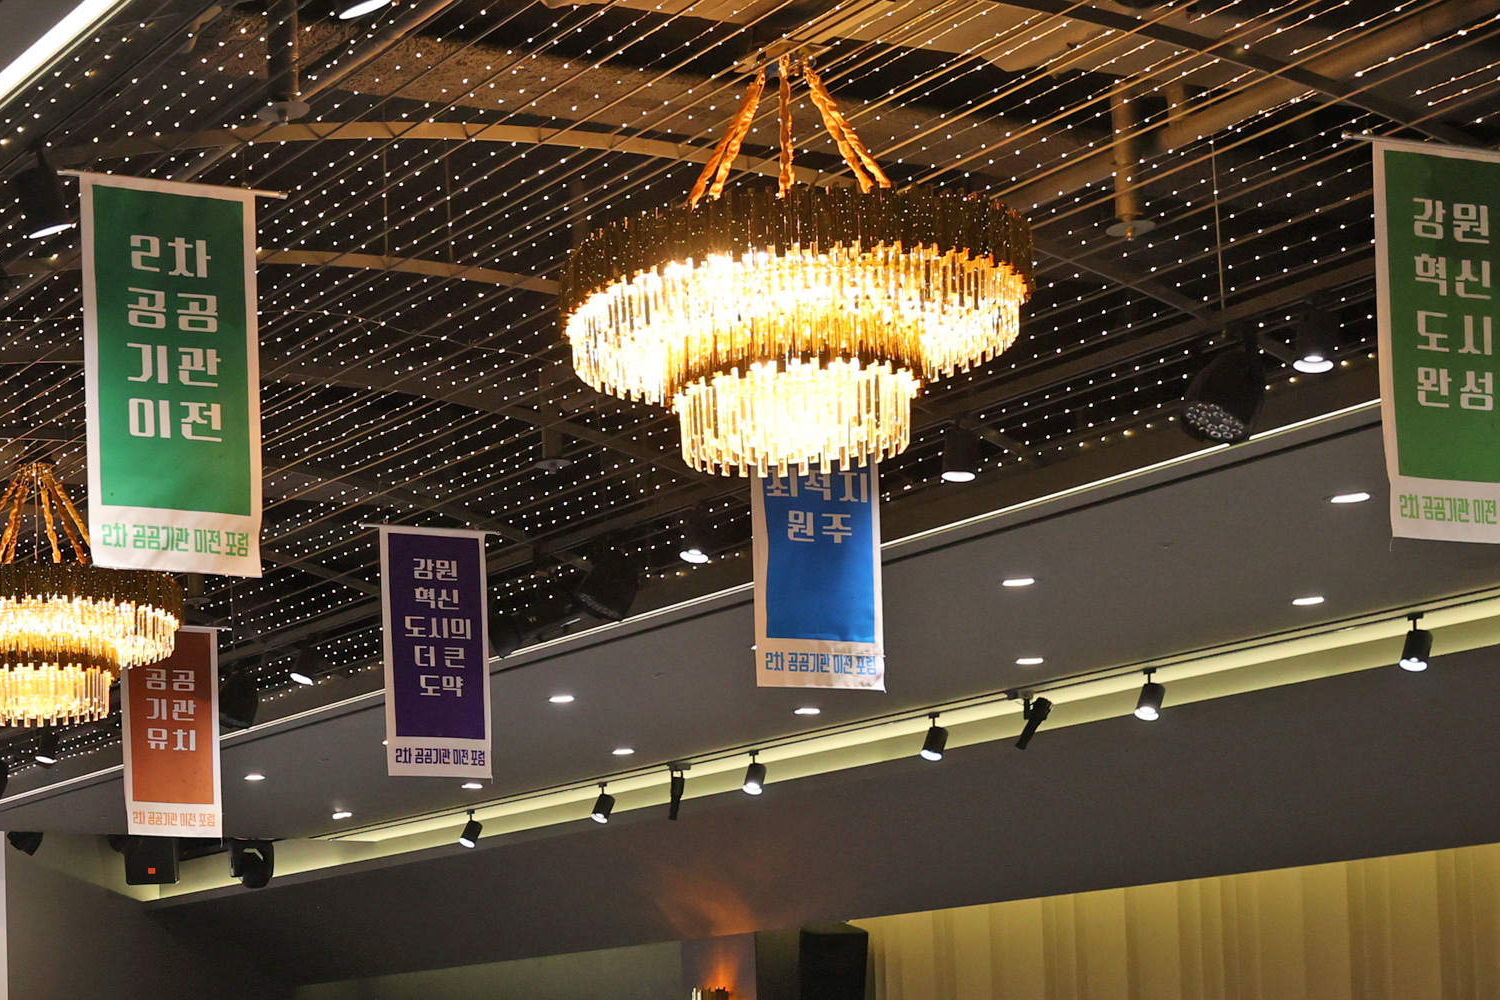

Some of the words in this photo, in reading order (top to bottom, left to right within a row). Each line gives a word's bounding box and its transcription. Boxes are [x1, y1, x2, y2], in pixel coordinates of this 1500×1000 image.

[1413, 198, 1489, 244] 강원
[130, 234, 211, 278] 2차
[1414, 253, 1491, 300] 혁신
[128, 286, 218, 333] 공공
[1417, 310, 1492, 356] 도시
[127, 342, 221, 387] 기관
[1417, 366, 1493, 411] 완성
[128, 397, 222, 442] 이전
[1399, 493, 1420, 519] 2차
[1422, 495, 1470, 523] 공공기관
[1473, 499, 1497, 525] 이전
[102, 523, 128, 548] 2차
[133, 524, 190, 552] 공공기관
[194, 528, 221, 554] 이전
[225, 531, 249, 557] 포럼
[788, 510, 852, 543] 원주
[413, 558, 458, 582] 강원
[414, 586, 459, 610] 혁신
[404, 615, 472, 640] 도시의
[414, 645, 436, 667] 더
[444, 646, 465, 669] 큰
[765, 651, 784, 671] 2차
[788, 652, 830, 673] 공공기관
[834, 655, 853, 675] 이전
[856, 656, 877, 675] 포럼
[146, 668, 196, 692] 공공
[419, 674, 464, 698] 도약
[146, 698, 196, 721] 기관
[147, 727, 196, 751] 유치
[395, 747, 412, 764] 2차
[415, 747, 451, 765] 공공기관
[453, 749, 469, 766] 이전
[471, 749, 486, 767] 포럼
[132, 811, 145, 825] 2차
[148, 811, 177, 826] 공공기관
[180, 813, 196, 827] 이전
[199, 813, 215, 827] 포럼
